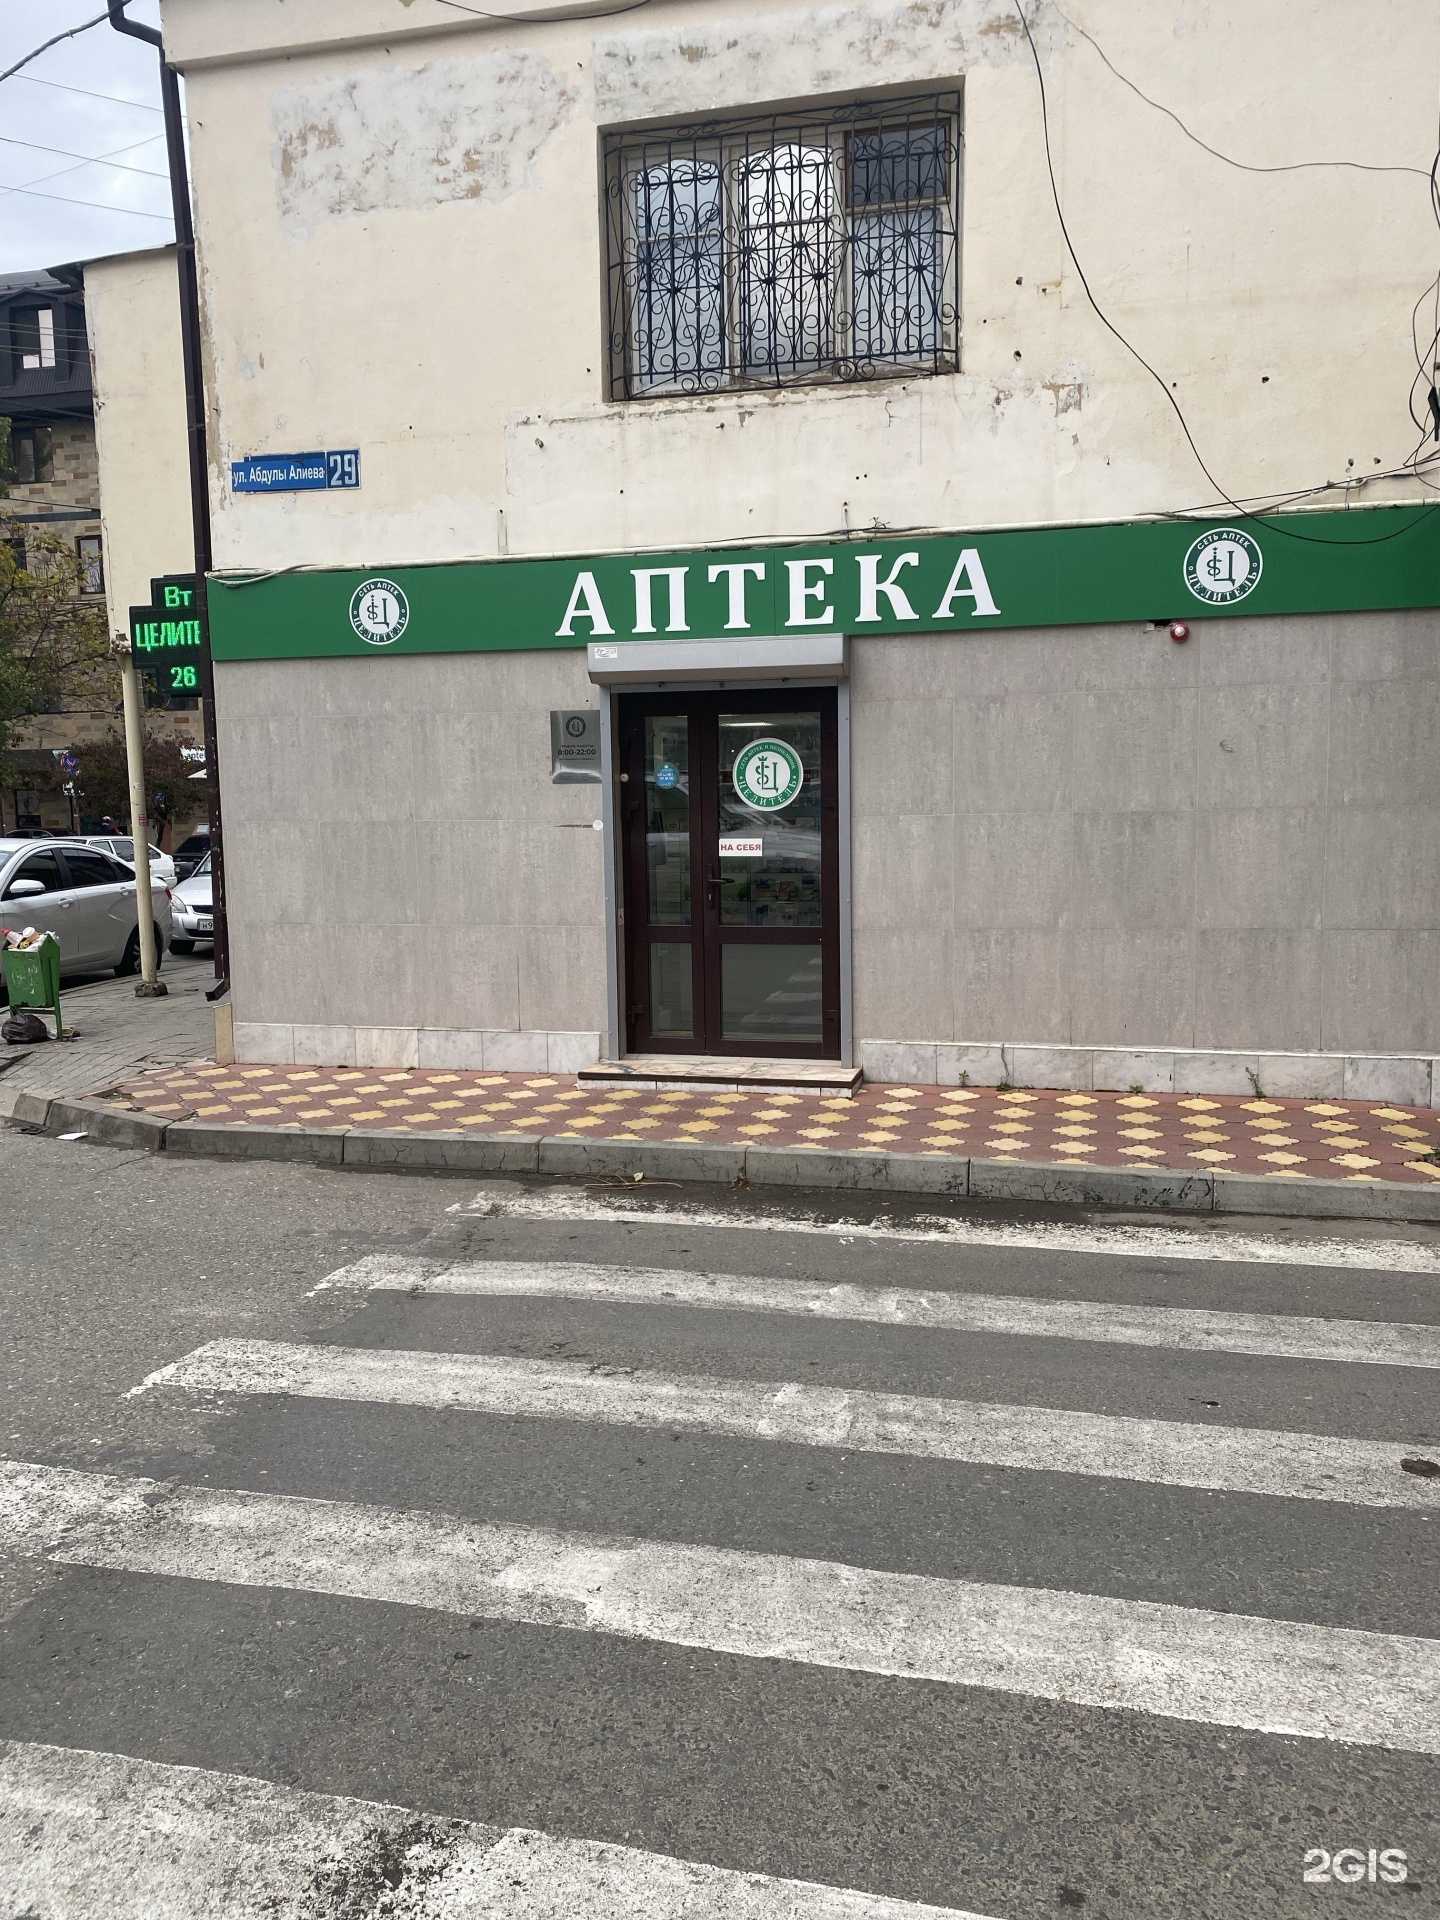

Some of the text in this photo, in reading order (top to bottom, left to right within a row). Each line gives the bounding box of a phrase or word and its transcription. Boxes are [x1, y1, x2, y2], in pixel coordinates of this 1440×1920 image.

[233, 453, 357, 487] ул. Абдулы Алиева 29
[1197, 532, 1251, 550] СЕТЬ АПТЕК
[164, 586, 193, 607] Вт
[358, 581, 400, 598] СЕТЬ АПТЕК
[555, 548, 1001, 637] АПТЕКА
[1188, 572, 1258, 601] ЦЕЛИТЕЛЬ
[353, 617, 406, 642] ЦЕЛИТЕЛЬ
[170, 666, 196, 688] 26
[738, 780, 797, 806] ЦЕЛИТЕЛЬ
[736, 843, 761, 852] СЕБЯ
